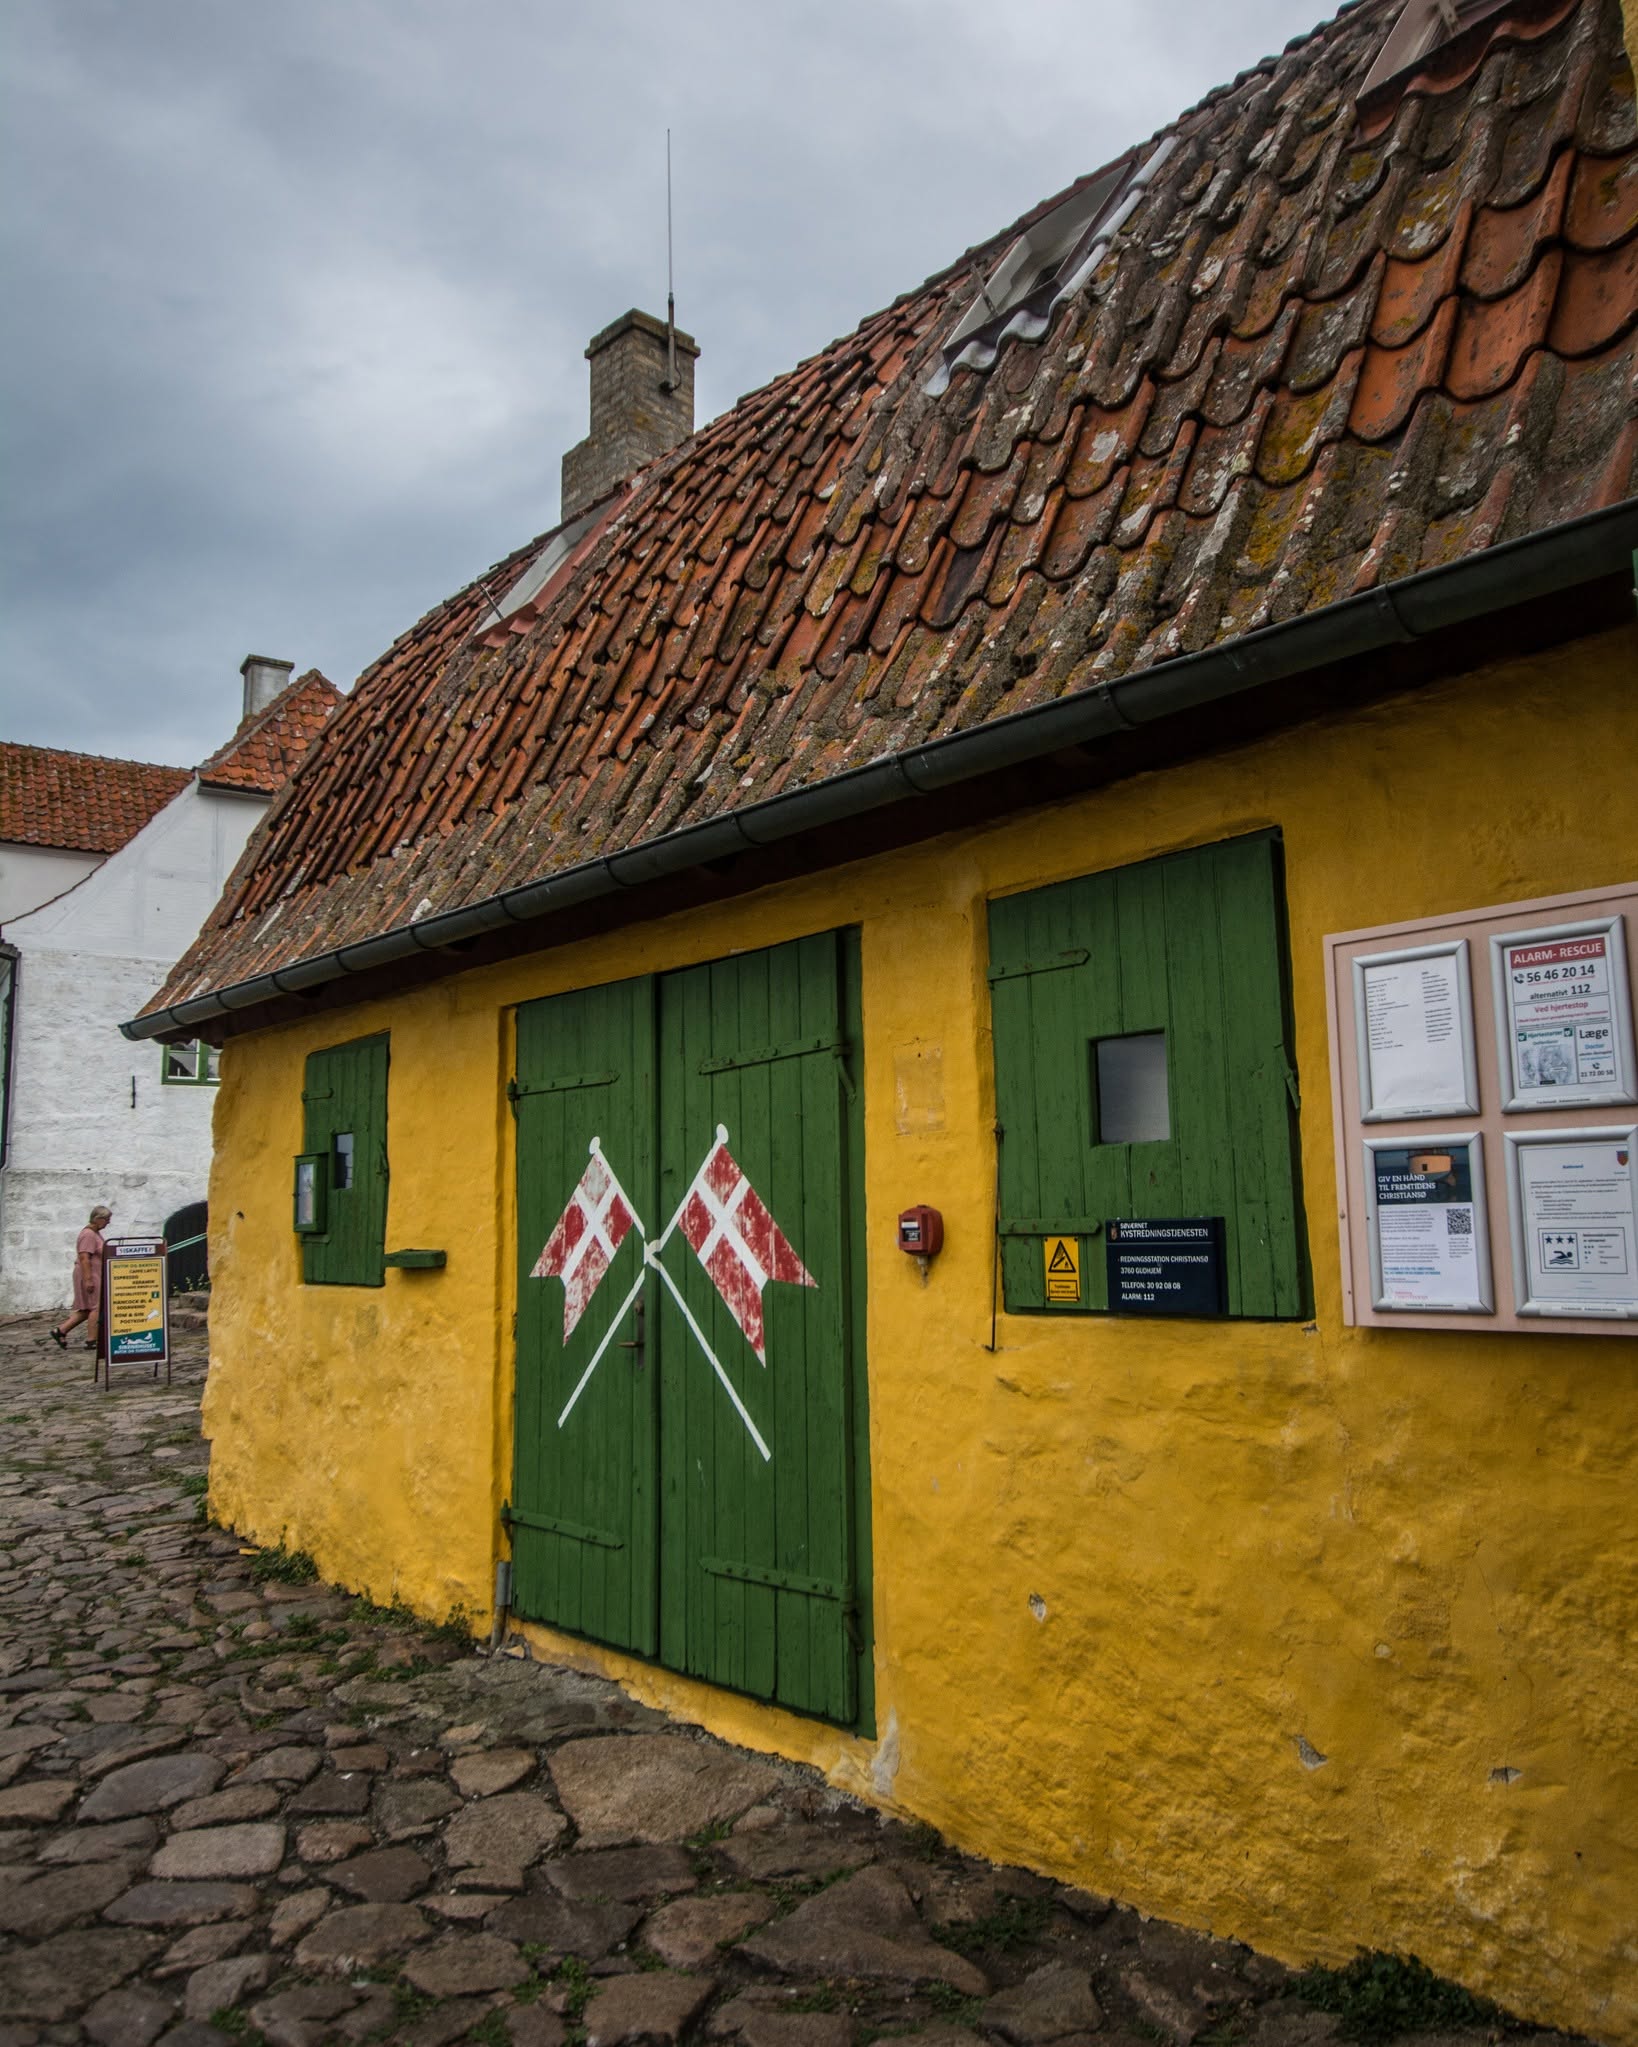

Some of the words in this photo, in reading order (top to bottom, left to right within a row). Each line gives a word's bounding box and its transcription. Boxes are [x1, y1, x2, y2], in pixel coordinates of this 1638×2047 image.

[1513, 949, 1557, 964] ALARM-
[1559, 942, 1602, 958] RESCUE
[1526, 971, 1541, 983] 56
[1544, 969, 1559, 980] 46
[1562, 966, 1577, 978] 20
[1580, 964, 1595, 976] 14
[1530, 989, 1569, 1000] alternativt
[1571, 983, 1591, 995] 112
[1550, 1001, 1589, 1012] hjertestop
[1579, 1028, 1609, 1040] Læge
[1378, 1175, 1391, 1183] GIV
[1403, 1173, 1426, 1182] HÅND
[1391, 1182, 1436, 1190] FREMTIDENS
[1379, 1191, 1427, 1200] CHRISTIANSØ
[1120, 1222, 1148, 1230] SØVÆRNET
[1120, 1228, 1209, 1239] KYSTREDNINGSTJENESTEN
[1119, 1255, 1170, 1264] REDNINGSSTATION
[1170, 1255, 1209, 1264] CHRISTIANSØ
[1121, 1281, 1146, 1290] TELEFON:
[1146, 1281, 1155, 1290] 30
[1155, 1281, 1164, 1290] 92
[1163, 1282, 1172, 1290] 08
[1172, 1282, 1181, 1290] 08
[1121, 1292, 1143, 1301] ALARM:
[1143, 1292, 1155, 1301] 112
